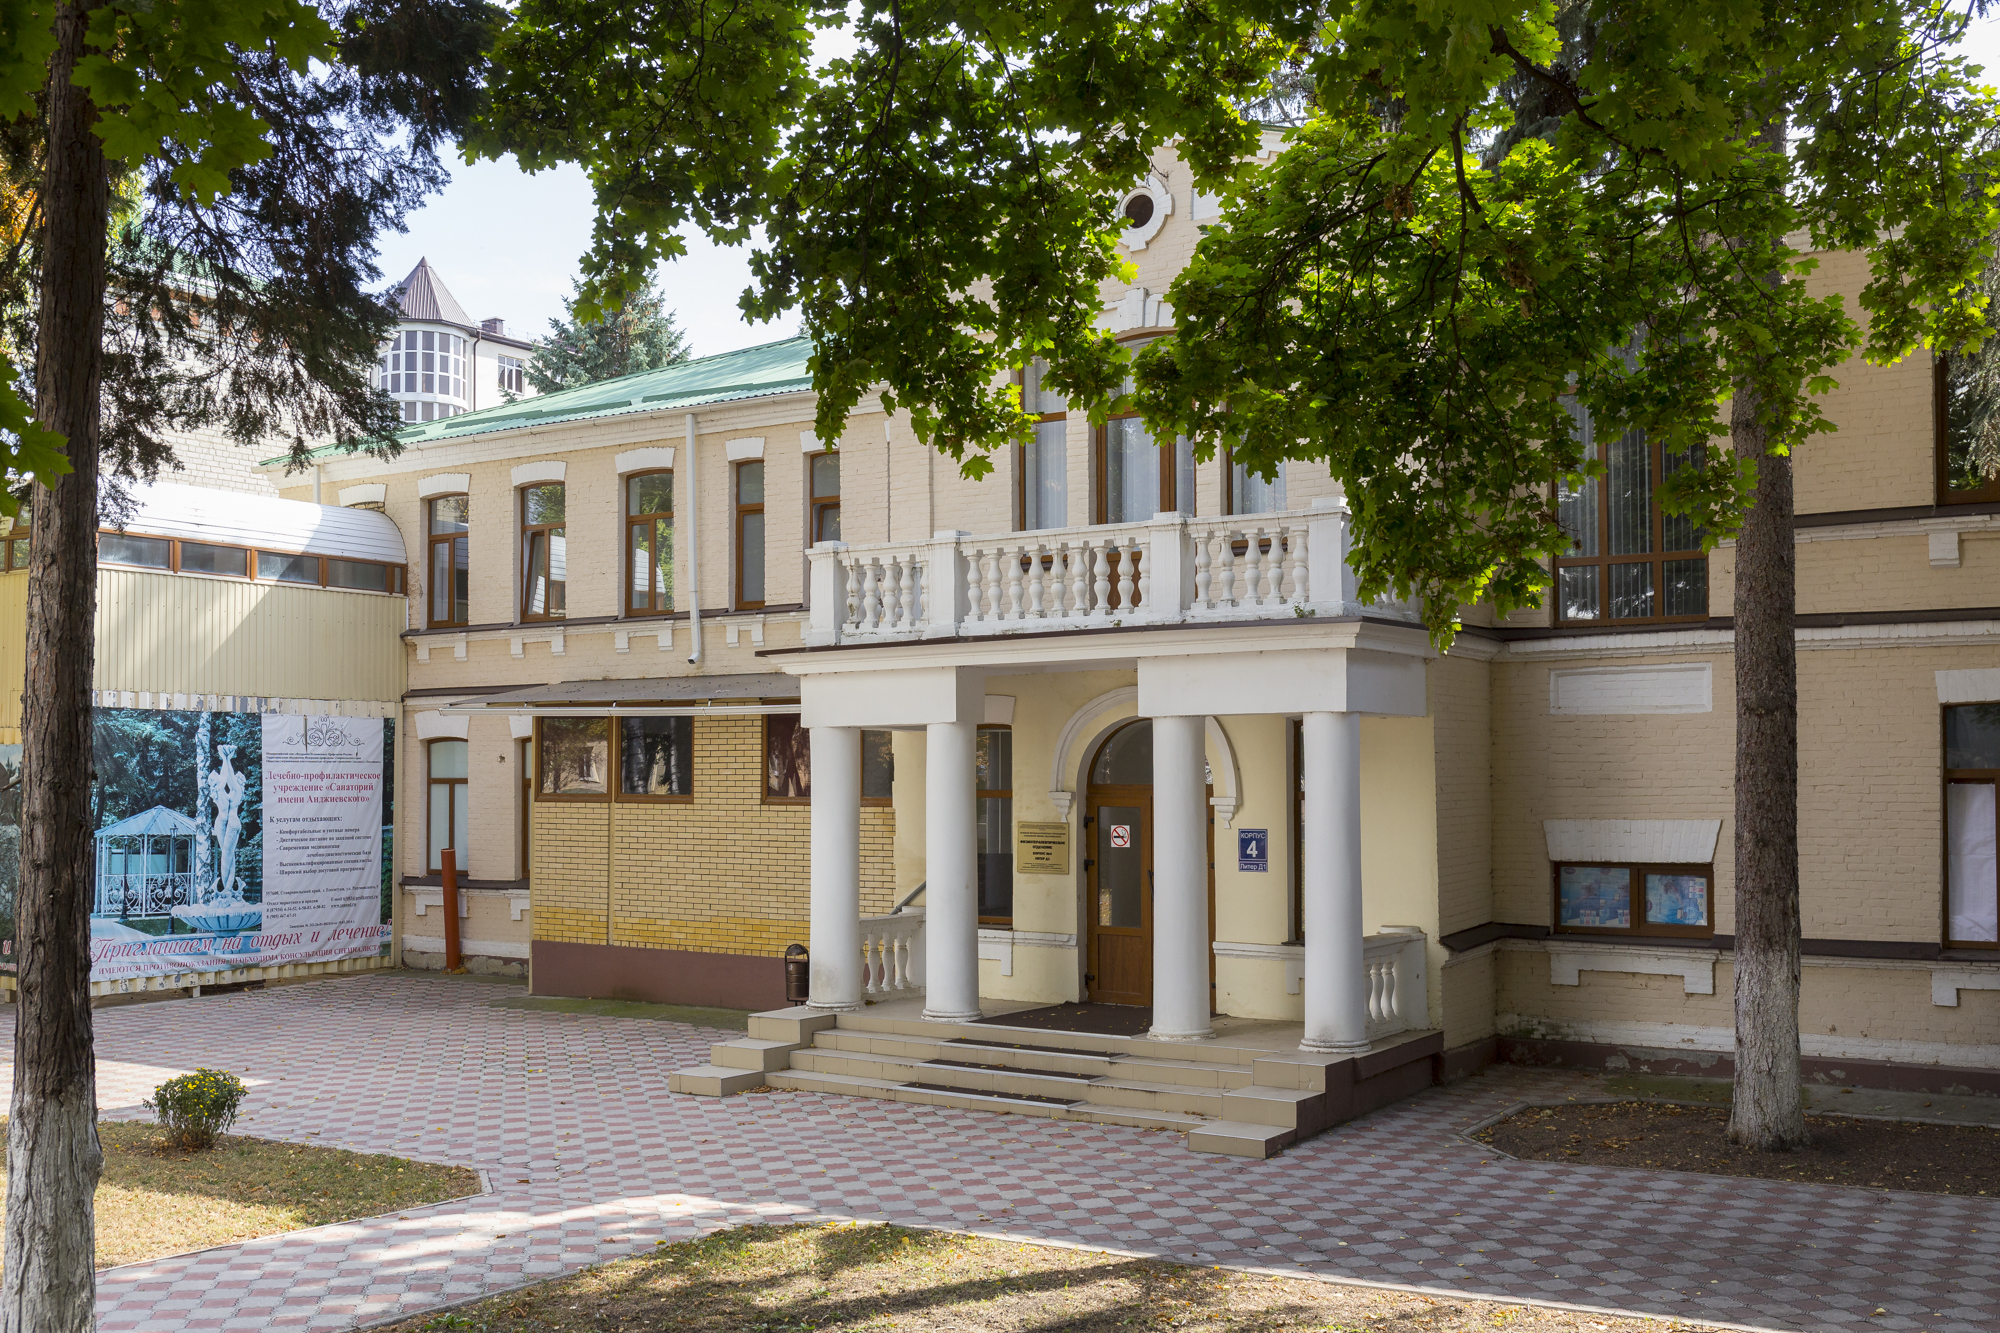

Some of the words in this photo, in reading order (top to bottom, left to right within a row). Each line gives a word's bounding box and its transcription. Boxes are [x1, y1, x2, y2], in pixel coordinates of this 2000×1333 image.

[265, 771, 381, 782] Лечебно-профилактическое
[273, 784, 323, 794] учреждение
[326, 783, 374, 793] «Санаторий
[307, 795, 370, 803] Анджиевского»
[1246, 840, 1258, 858] 4
[90, 938, 213, 968] Приглашаем
[221, 937, 241, 950] на
[250, 932, 303, 950] отдых
[310, 931, 320, 943] и
[328, 919, 392, 941] лечение!
[98, 963, 141, 975] ИМЕЮТСЯ
[229, 955, 279, 965] НЕОБХОДИМА
[280, 949, 332, 960] КОНСУЛЬТАЦИЯ
